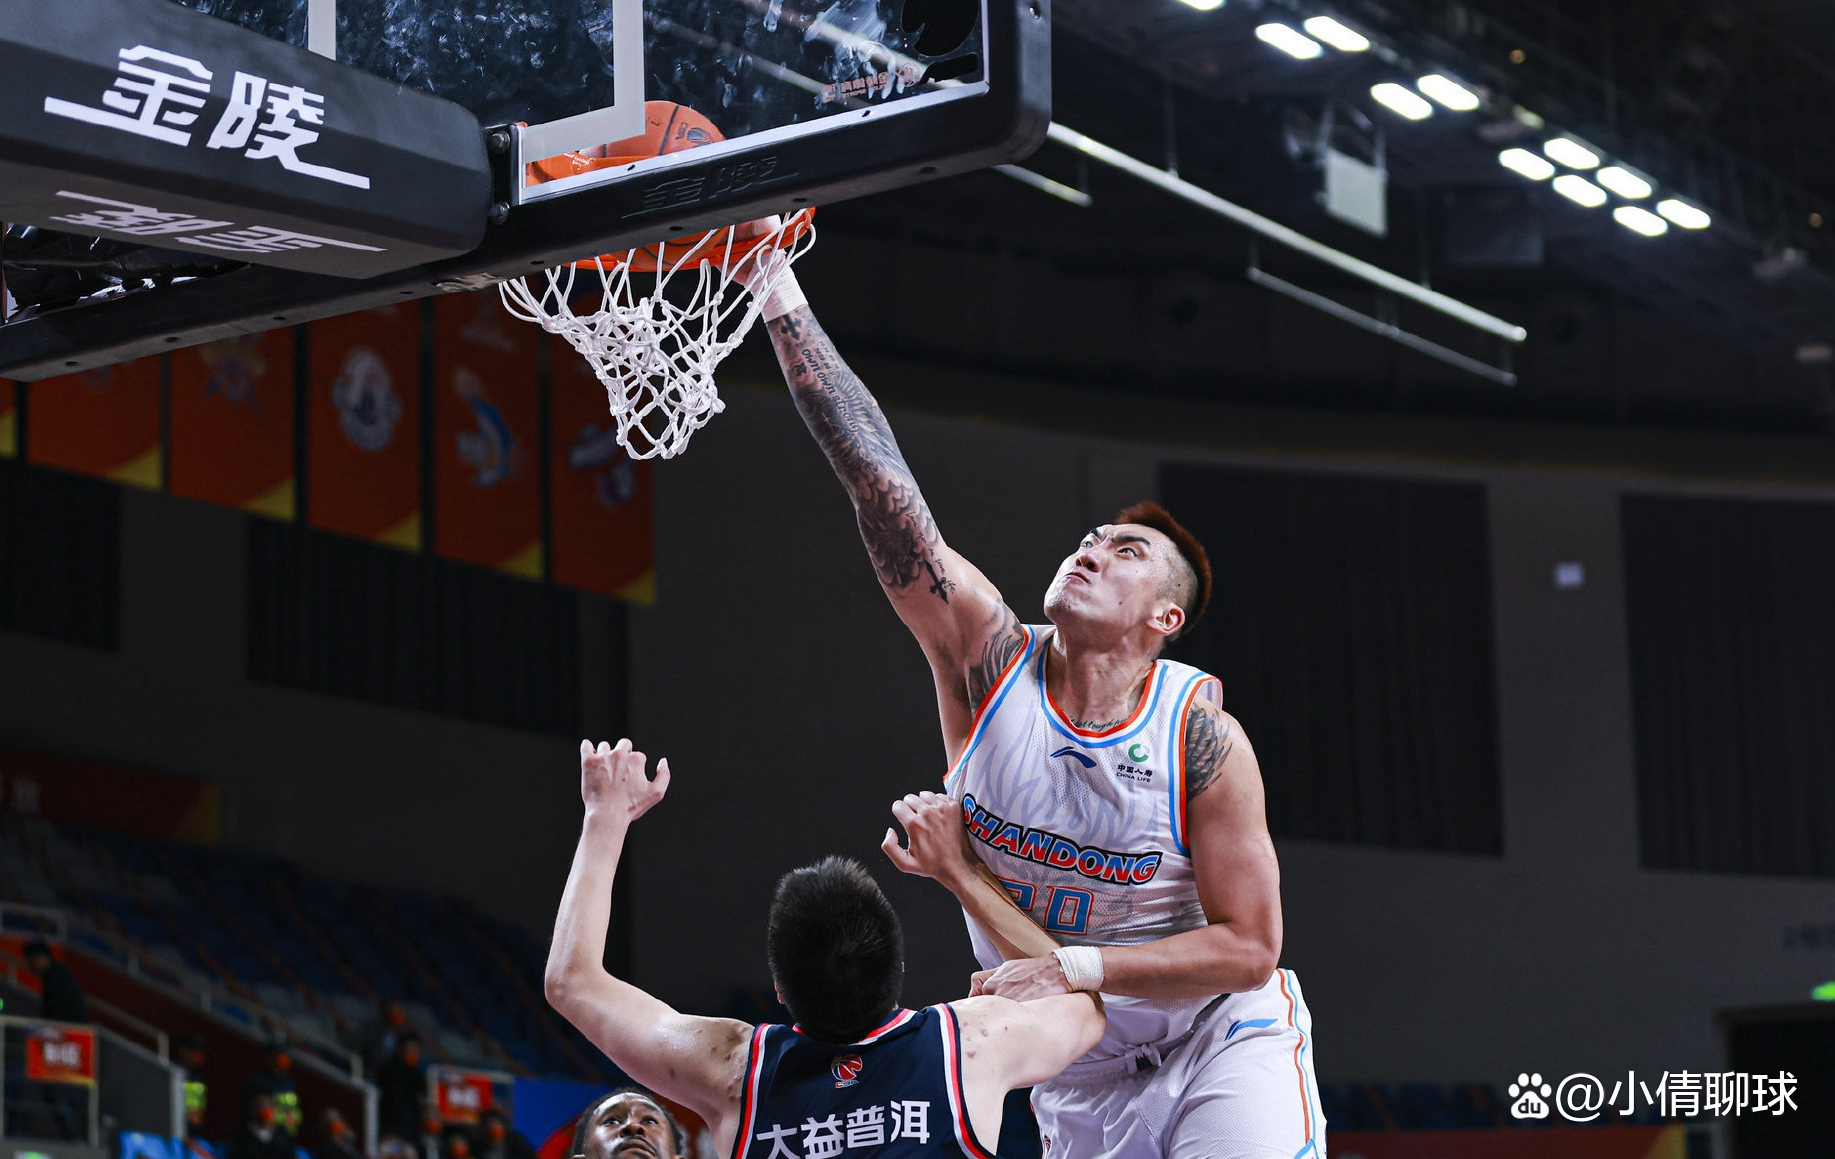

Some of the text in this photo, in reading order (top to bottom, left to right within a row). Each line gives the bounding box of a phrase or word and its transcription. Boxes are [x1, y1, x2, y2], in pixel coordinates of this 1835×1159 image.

[44, 45, 370, 189] 金陵
[1115, 771, 1152, 783] CHINA LIFE
[962, 793, 1163, 886] SHANDONG
[756, 1100, 931, 1159] 大益普洱
